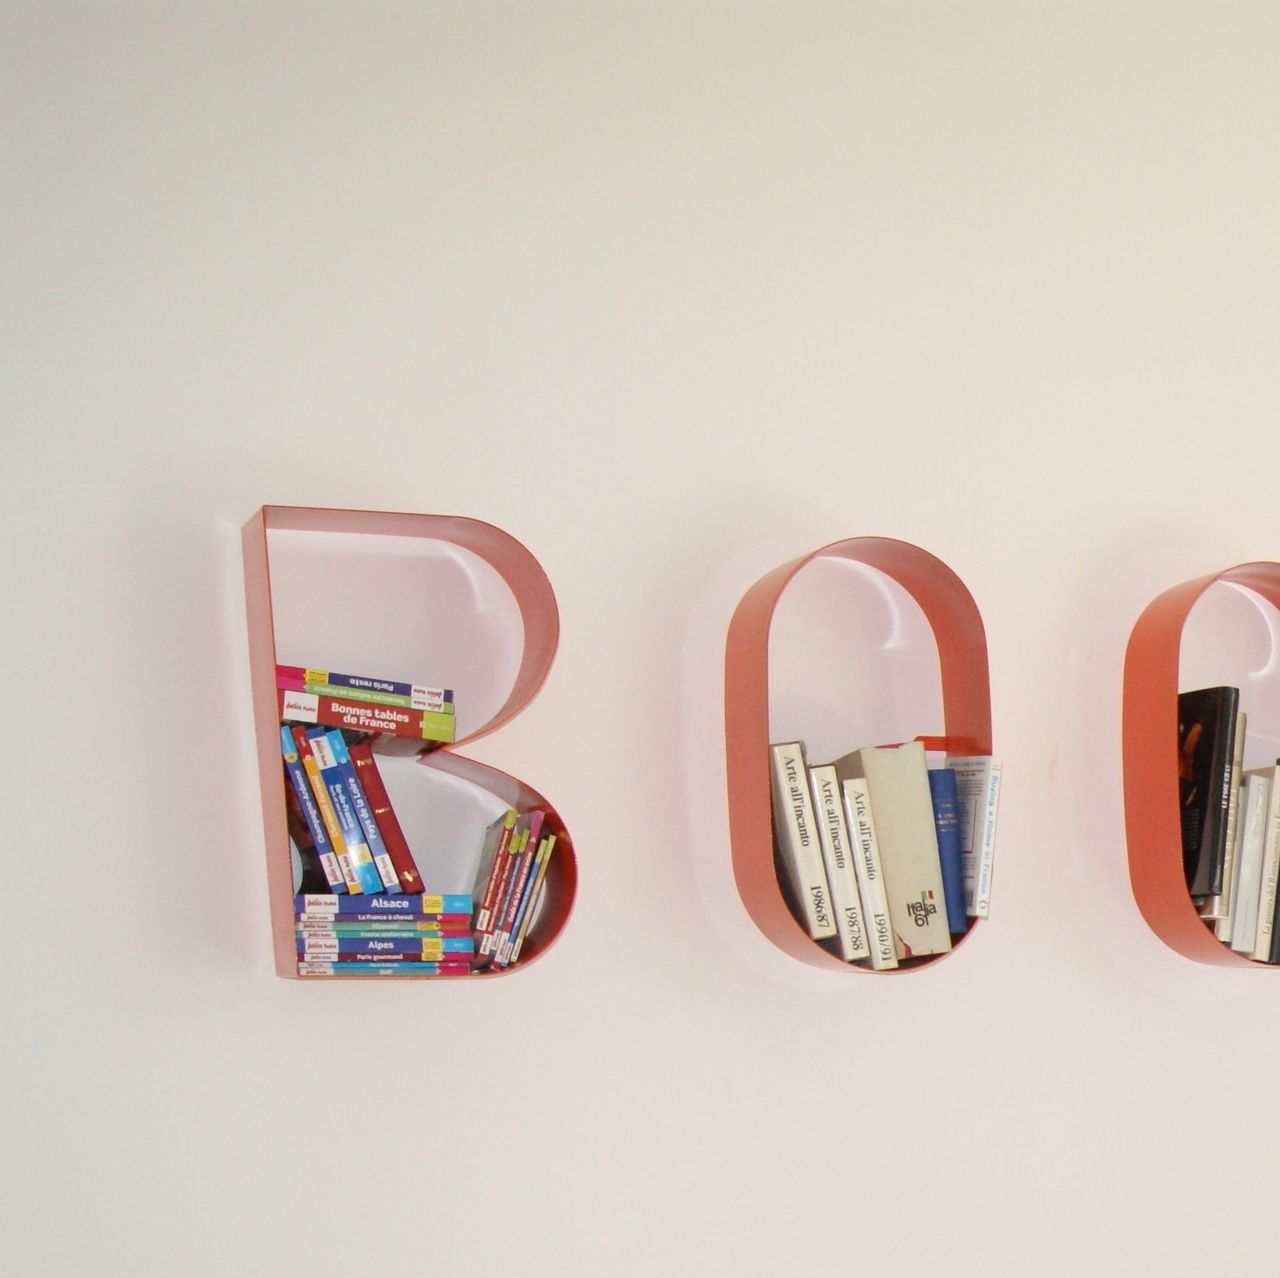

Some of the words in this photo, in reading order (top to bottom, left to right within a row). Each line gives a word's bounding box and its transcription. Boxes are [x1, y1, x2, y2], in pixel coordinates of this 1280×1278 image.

[350, 678, 372, 688] resto
[373, 680, 394, 692] Paris
[331, 702, 372, 717] Bonnes
[374, 708, 409, 722] tables
[343, 715, 357, 724] de
[359, 716, 396, 730] France
[784, 756, 797, 783] Arte
[348, 777, 361, 799] Loire
[821, 779, 834, 806] Arte
[294, 770, 325, 844] Champagne-Ardenne
[356, 799, 365, 808] la
[360, 807, 368, 819] de
[854, 791, 867, 817] Arte
[790, 786, 811, 848] all'incanto
[365, 819, 377, 839] Pays
[827, 808, 845, 869] all'incanto
[859, 819, 876, 881] all'incanto
[371, 898, 409, 908] Alsace
[907, 899, 936, 918] Italia
[845, 906, 862, 951] 1987/88
[914, 912, 929, 927] 61
[874, 913, 892, 962] 1990/91
[1262, 925, 1269, 935] La
[368, 942, 394, 950] Alpes
